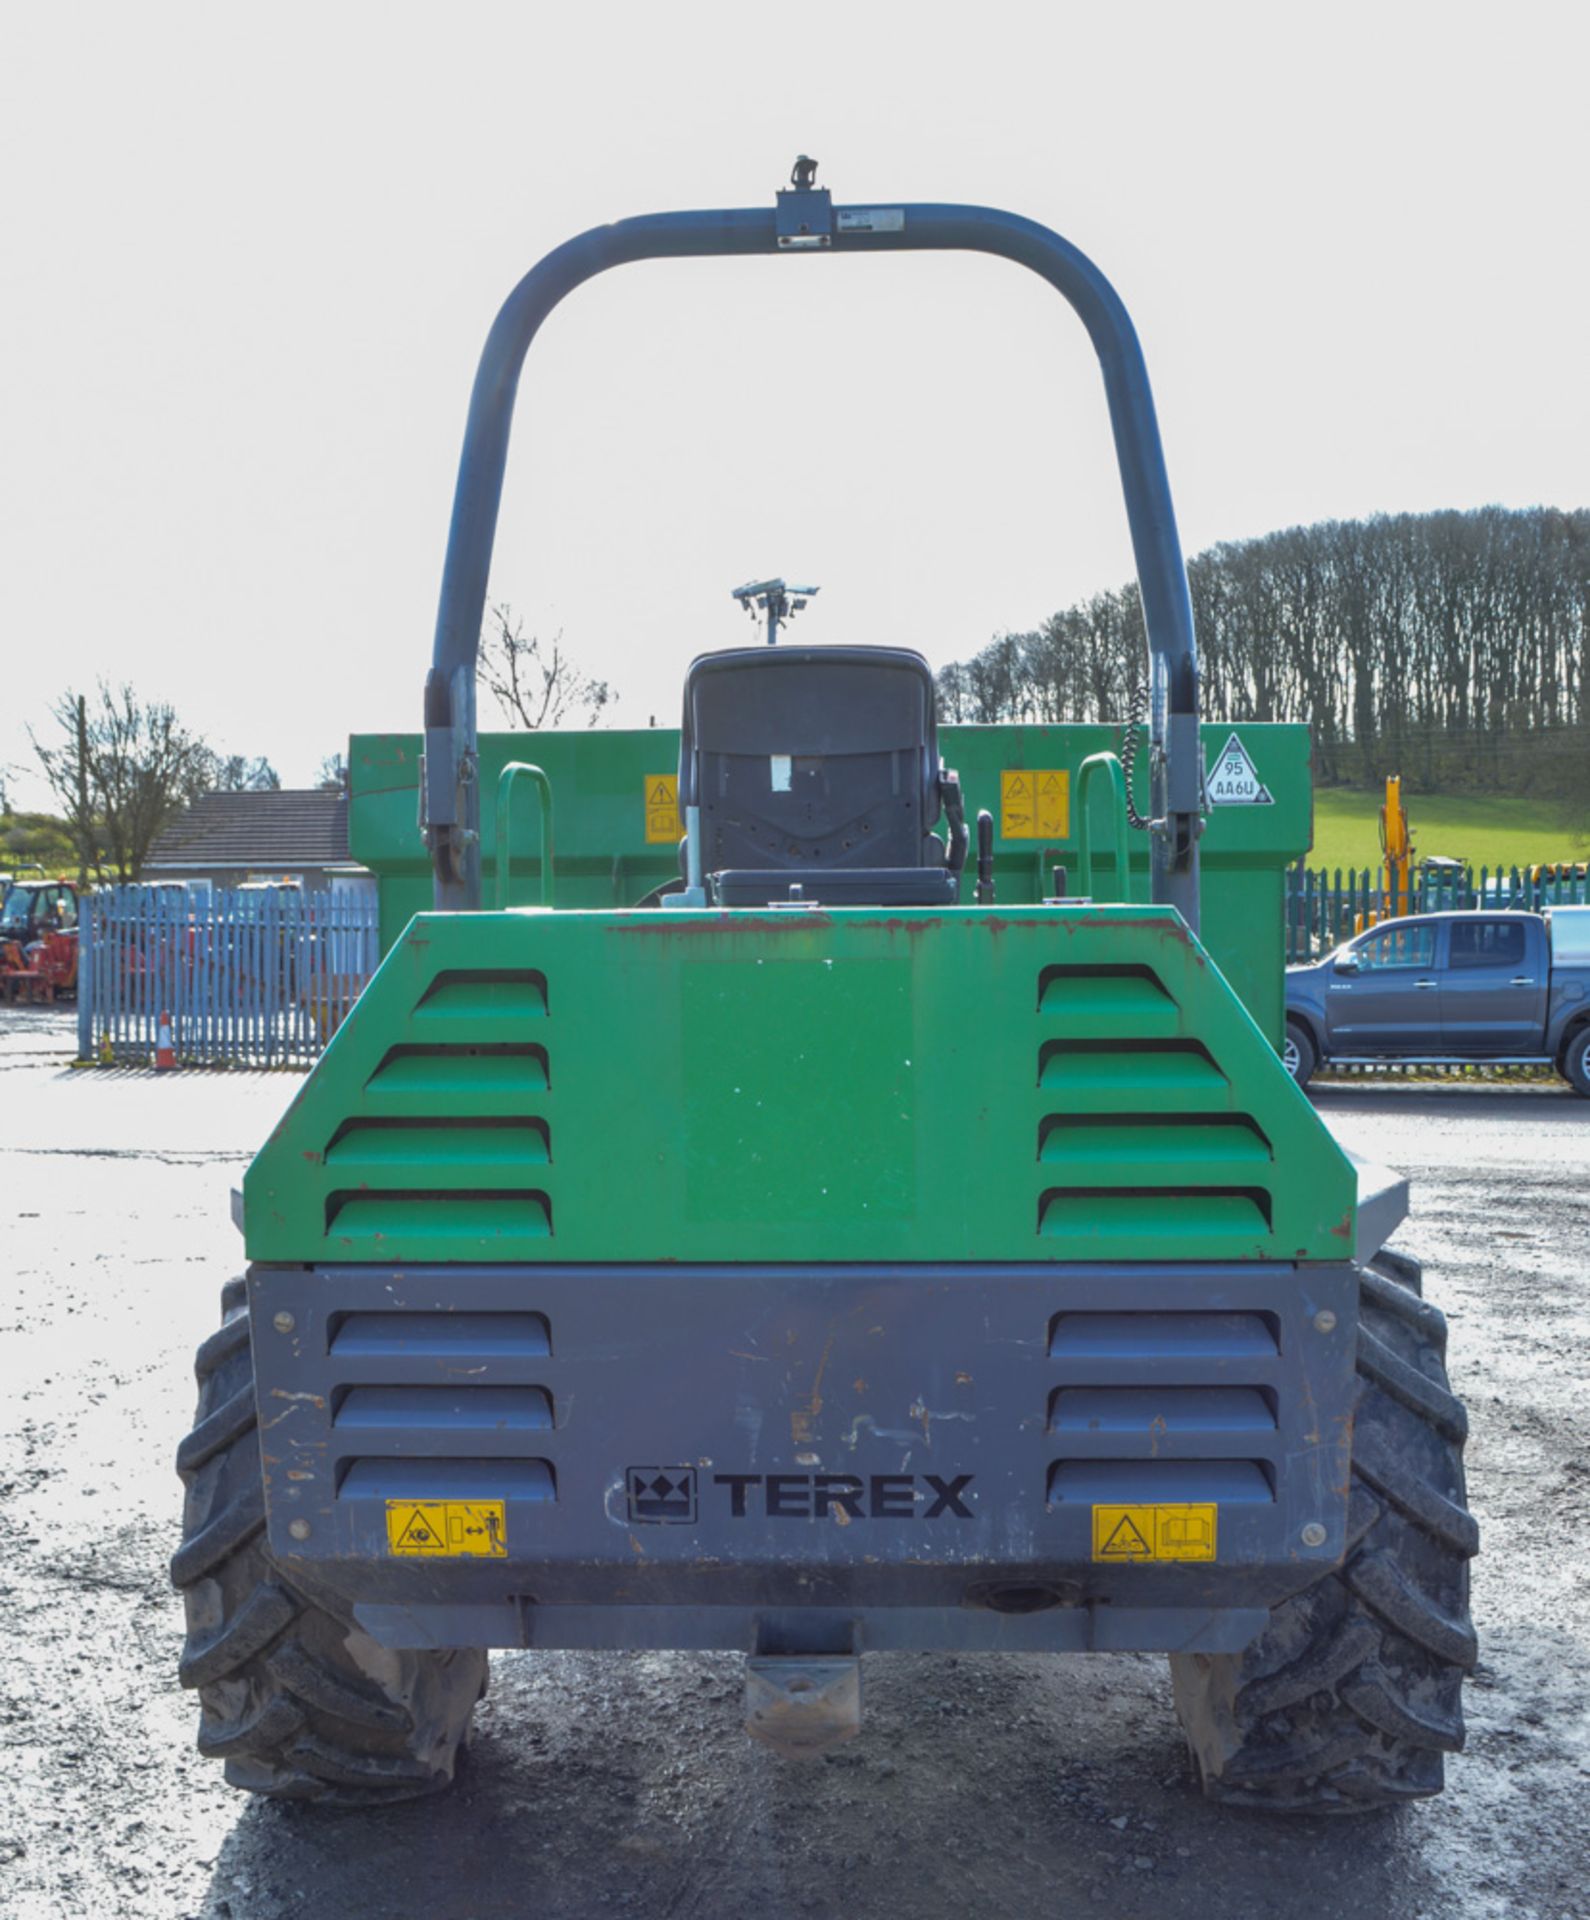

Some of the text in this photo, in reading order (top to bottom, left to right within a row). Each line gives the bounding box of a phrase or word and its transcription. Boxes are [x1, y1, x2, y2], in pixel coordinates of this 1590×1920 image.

[1225, 762, 1243, 775] 95
[1215, 781, 1254, 795] AA6U
[714, 1474, 975, 1518] TEREX
